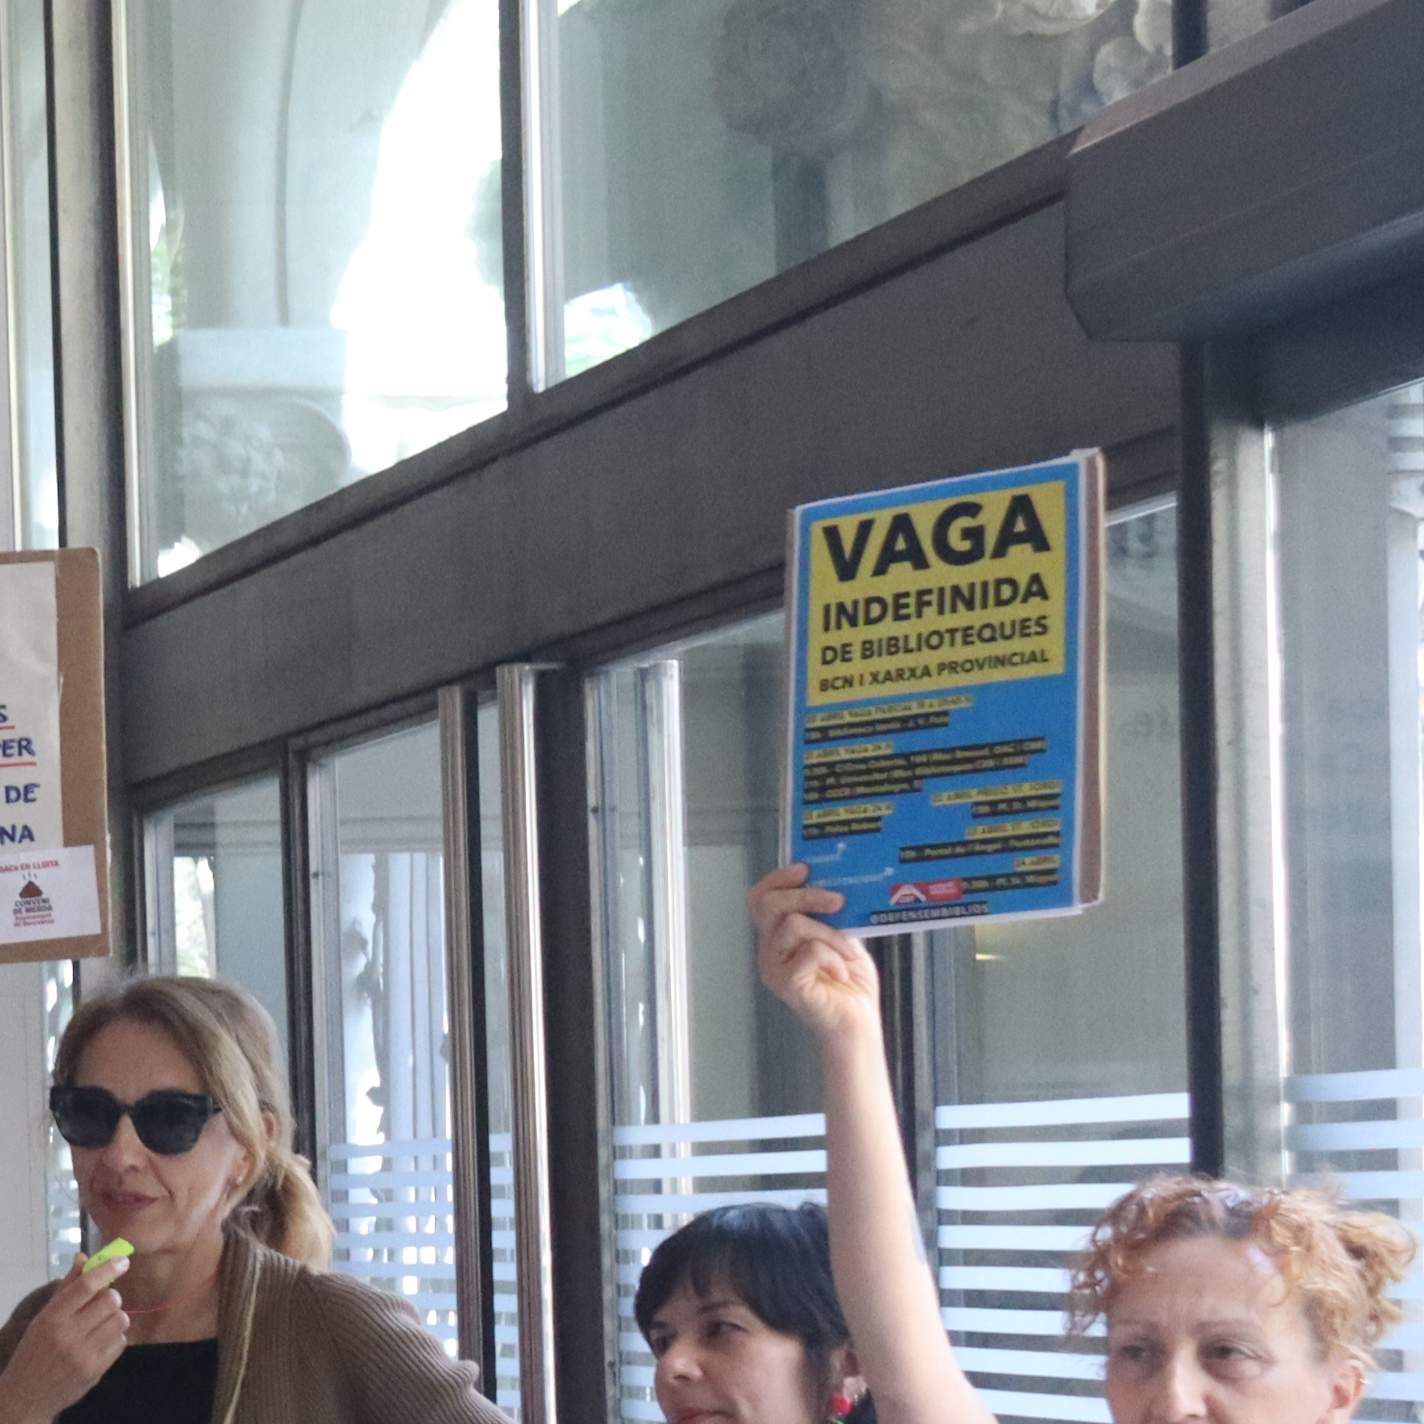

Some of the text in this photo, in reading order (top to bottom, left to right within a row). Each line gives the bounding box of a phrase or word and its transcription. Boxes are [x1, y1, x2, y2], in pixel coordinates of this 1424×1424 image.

[822, 493, 1051, 582] VAGA
[822, 572, 1049, 633] INDEFINIDA
[820, 615, 1049, 666] DE BIBLIOTEQUES
[819, 648, 1049, 693] BCN I XARXA PROVINCIAL
[4, 783, 40, 804] DE
